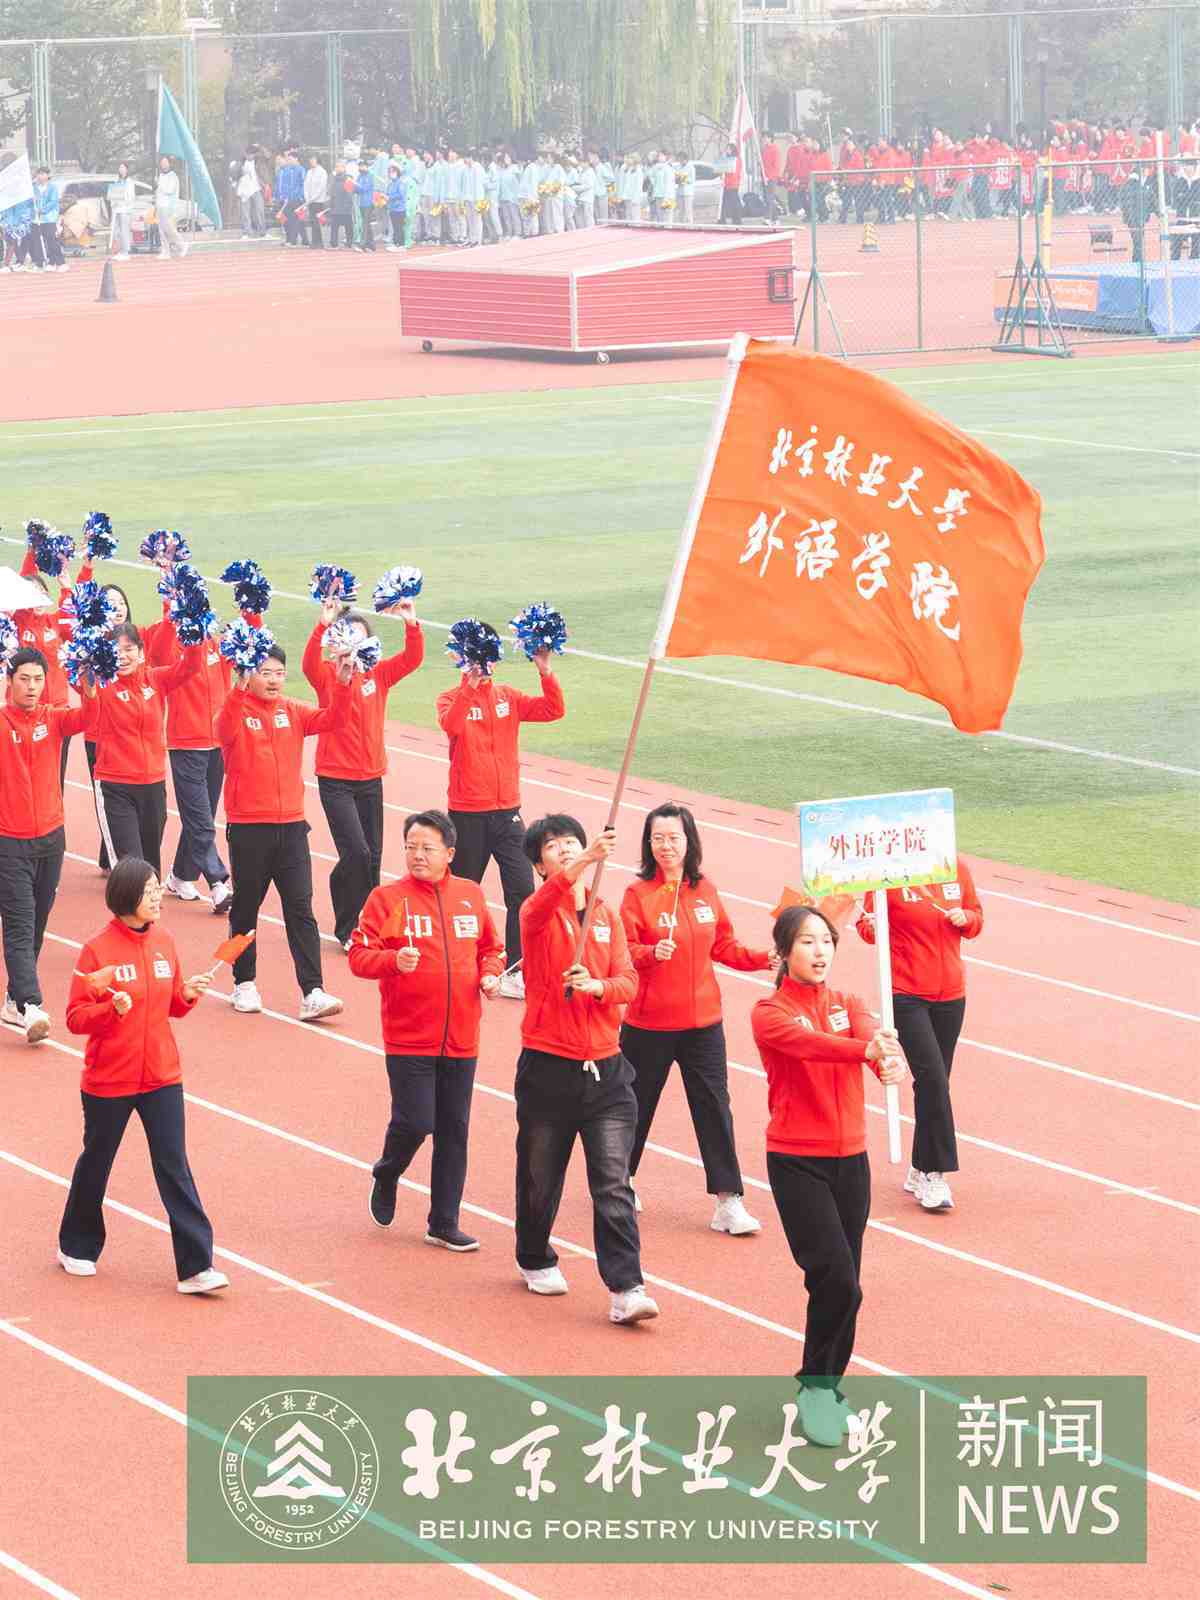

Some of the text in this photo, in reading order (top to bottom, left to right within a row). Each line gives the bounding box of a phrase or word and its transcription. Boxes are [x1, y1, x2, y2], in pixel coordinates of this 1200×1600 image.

[739, 509, 960, 640] 外语学院
[829, 826, 927, 861] 外语学院
